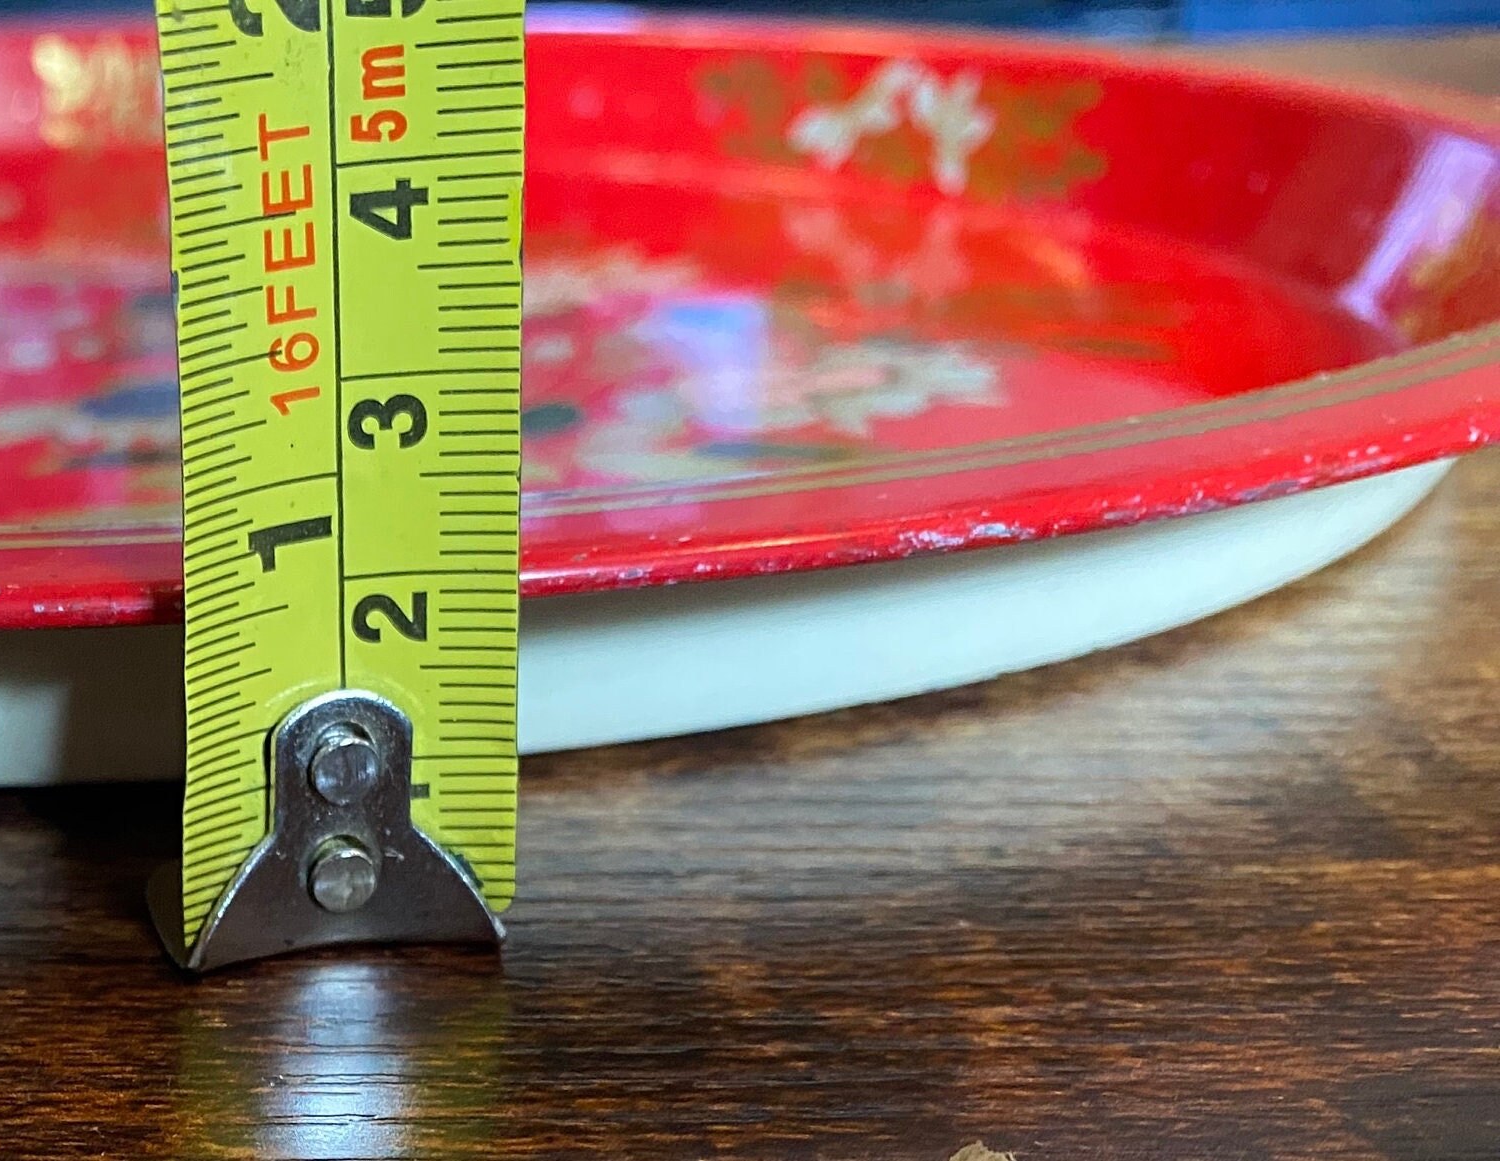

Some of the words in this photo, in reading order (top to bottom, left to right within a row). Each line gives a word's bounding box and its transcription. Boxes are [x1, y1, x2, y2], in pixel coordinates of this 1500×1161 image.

[350, 44, 407, 142] 5m
[349, 178, 429, 240] 4
[347, 394, 428, 450] 3
[248, 515, 333, 573] 1
[352, 591, 428, 643] 2
